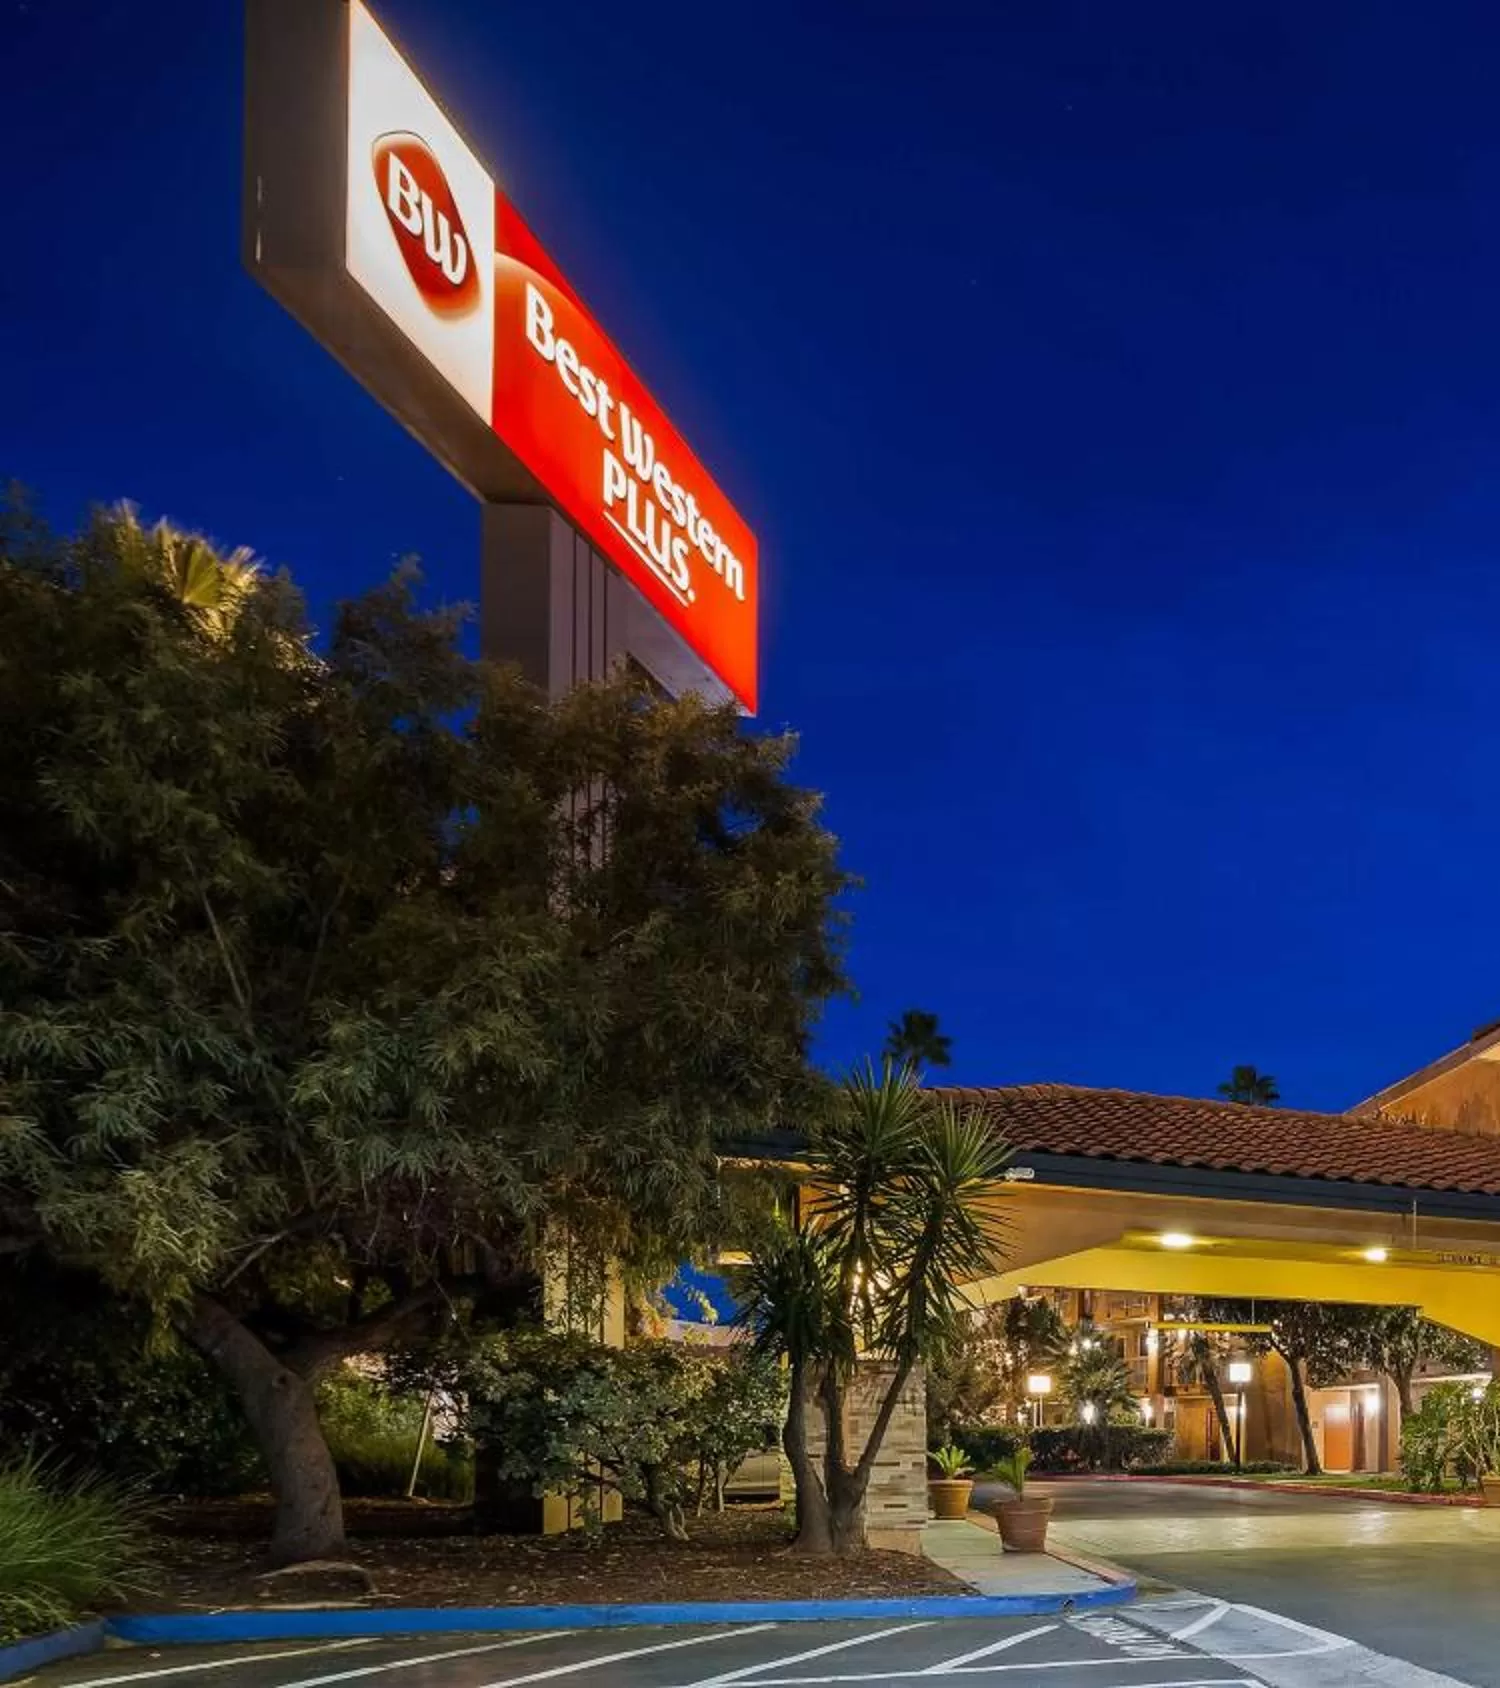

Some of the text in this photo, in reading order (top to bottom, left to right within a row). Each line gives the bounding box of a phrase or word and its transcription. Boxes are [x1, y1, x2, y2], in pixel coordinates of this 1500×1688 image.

[388, 151, 468, 286] BW
[526, 281, 745, 602] Best Western
[603, 447, 691, 592] PLUS
